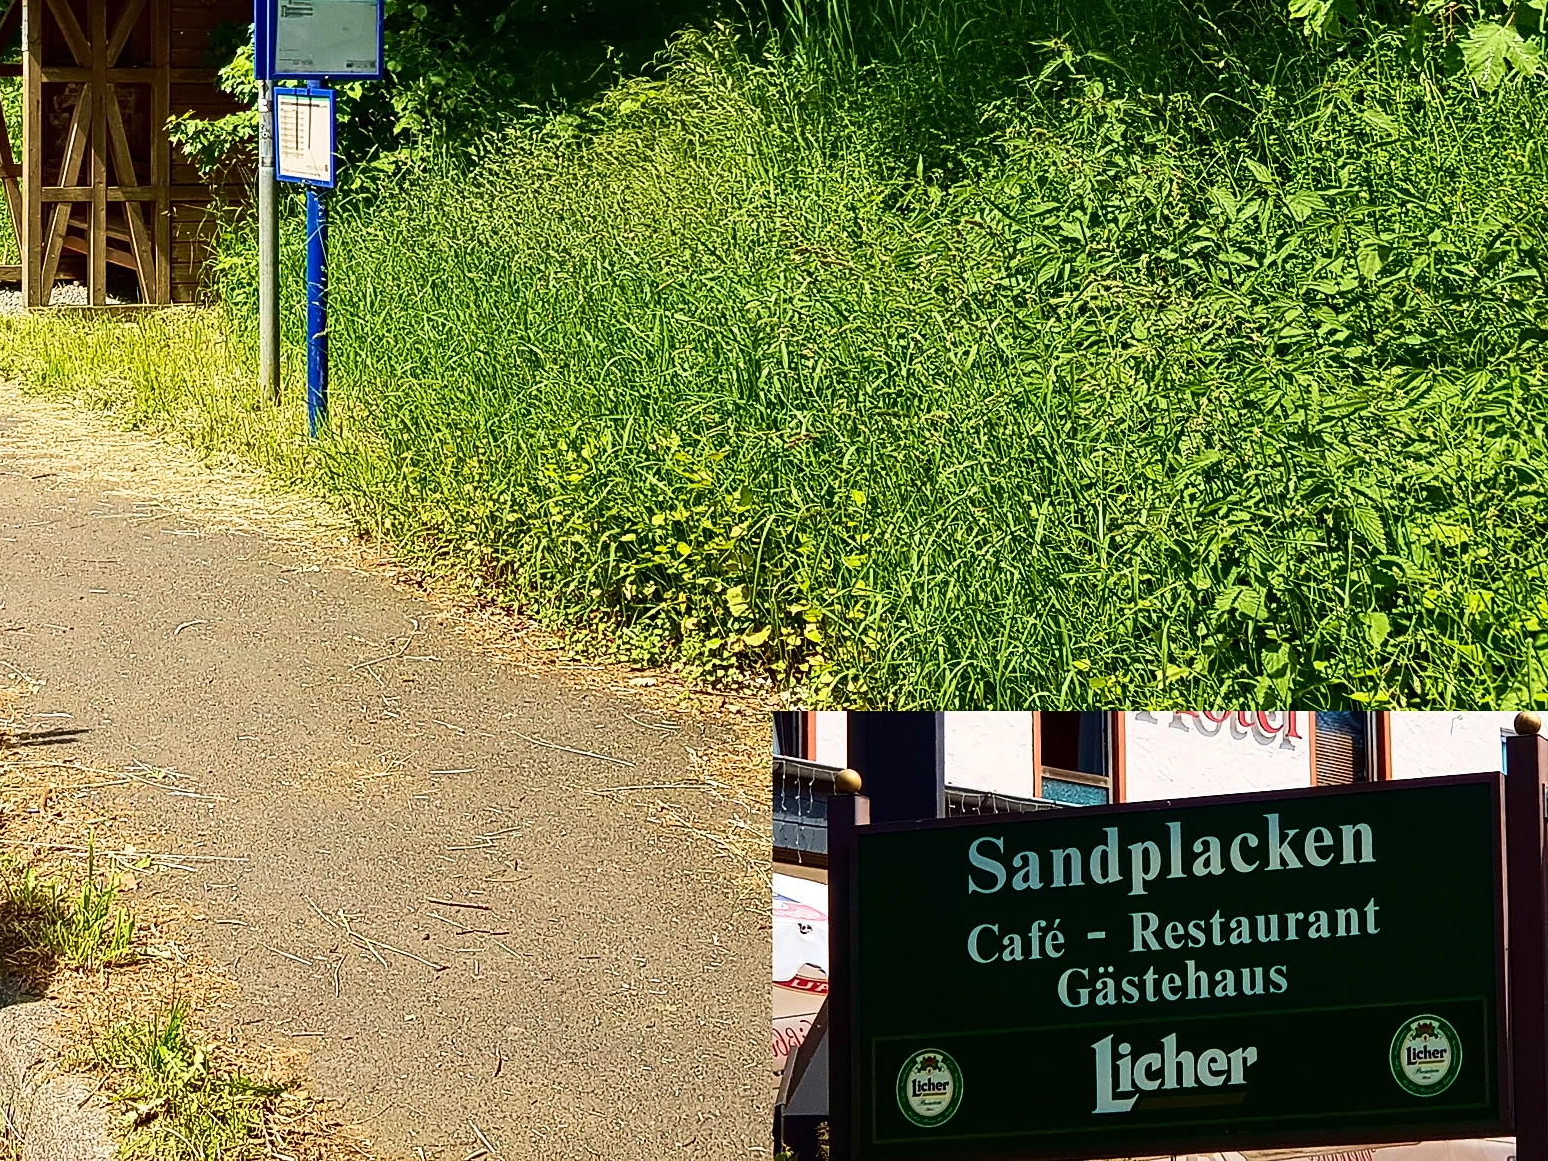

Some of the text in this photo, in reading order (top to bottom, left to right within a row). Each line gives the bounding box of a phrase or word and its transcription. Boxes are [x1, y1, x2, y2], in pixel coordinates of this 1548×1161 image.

[968, 813, 1377, 896] Sandplacken
[967, 918, 1065, 964] Café
[1128, 897, 1381, 953] Restaurant
[1057, 959, 1288, 1008] Gästehaus
[1090, 1032, 1258, 1114] Licher
[1406, 1044, 1447, 1066] Licher
[911, 1077, 950, 1097] Licher
